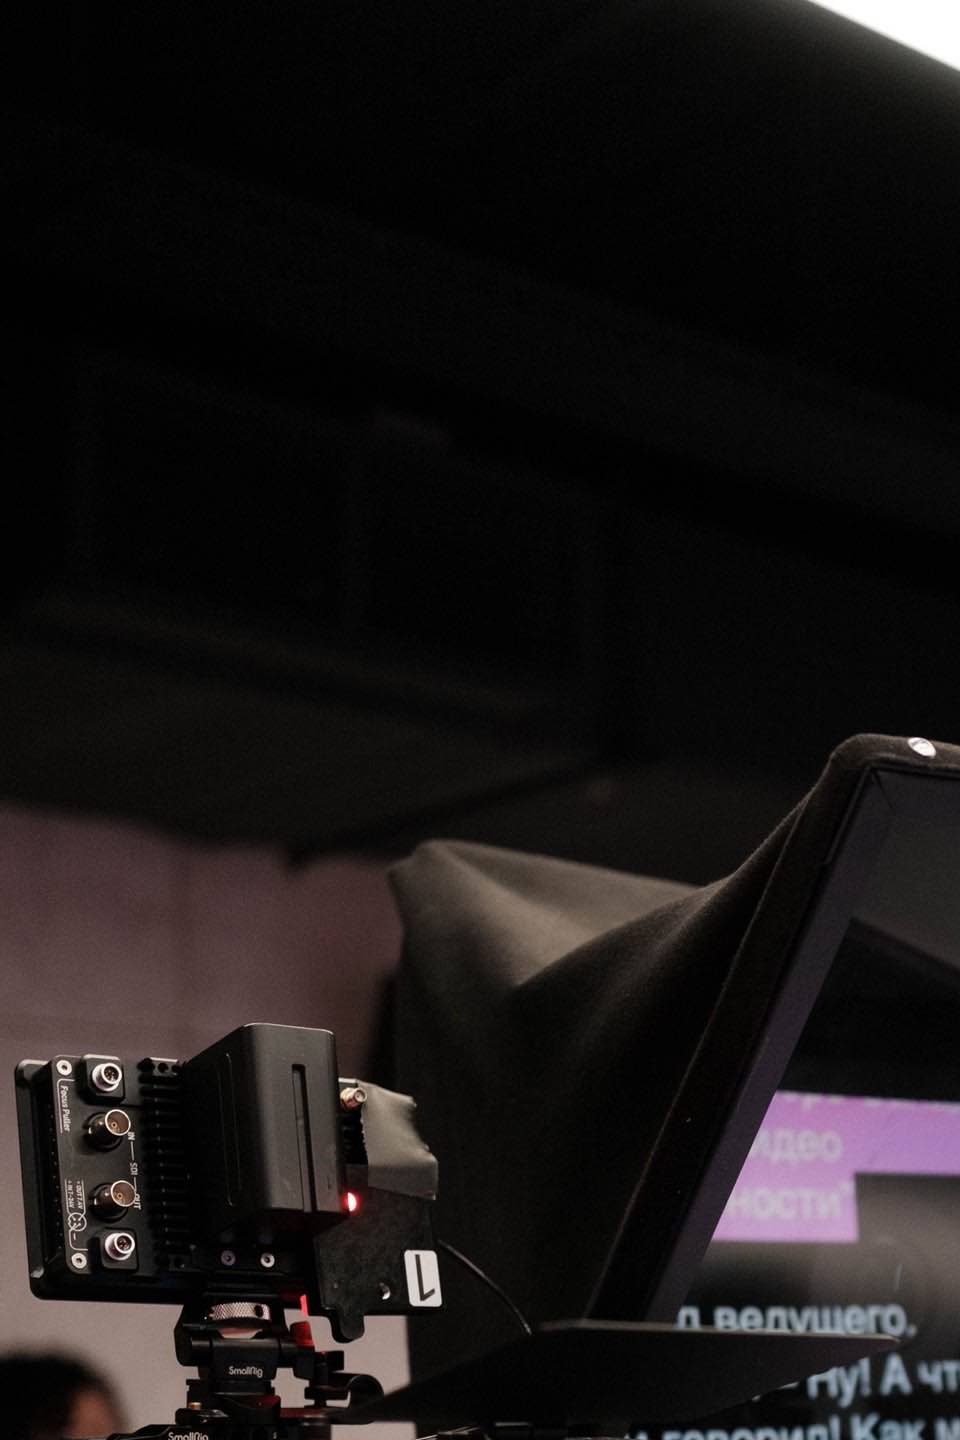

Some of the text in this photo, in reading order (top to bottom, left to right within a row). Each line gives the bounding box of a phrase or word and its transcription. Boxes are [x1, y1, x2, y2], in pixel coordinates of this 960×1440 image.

[60, 1086, 73, 1132] Focus Puller
[127, 1131, 135, 1141] IN
[749, 1129, 844, 1164] идео
[130, 1162, 138, 1175] SDI
[228, 1365, 264, 1378] SmallRig
[880, 1352, 913, 1396] А
